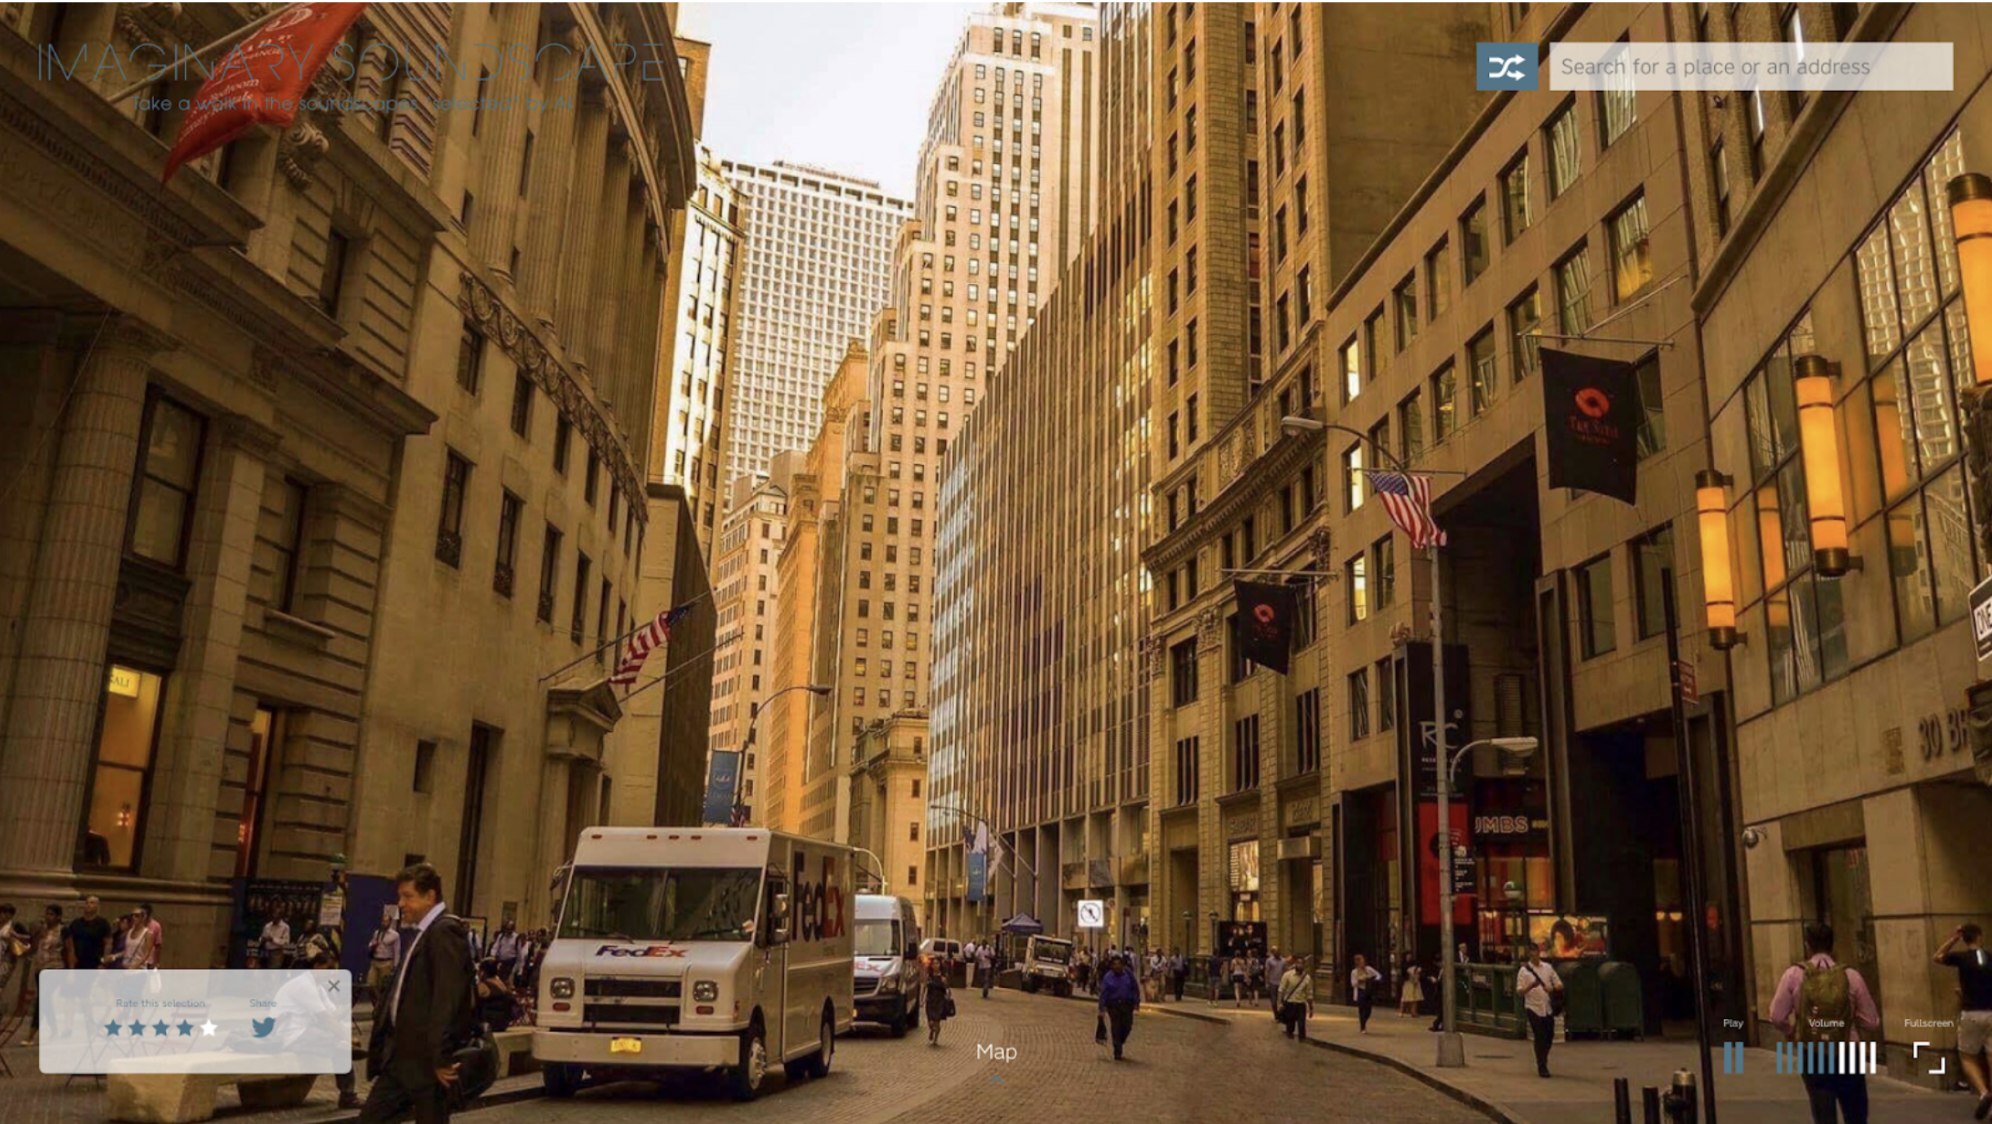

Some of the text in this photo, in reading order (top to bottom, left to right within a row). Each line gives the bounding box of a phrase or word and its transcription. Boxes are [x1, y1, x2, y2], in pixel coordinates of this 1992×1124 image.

[1919, 713, 1943, 762] 30
[792, 850, 846, 943] FedEx
[595, 945, 688, 958] FedEx
